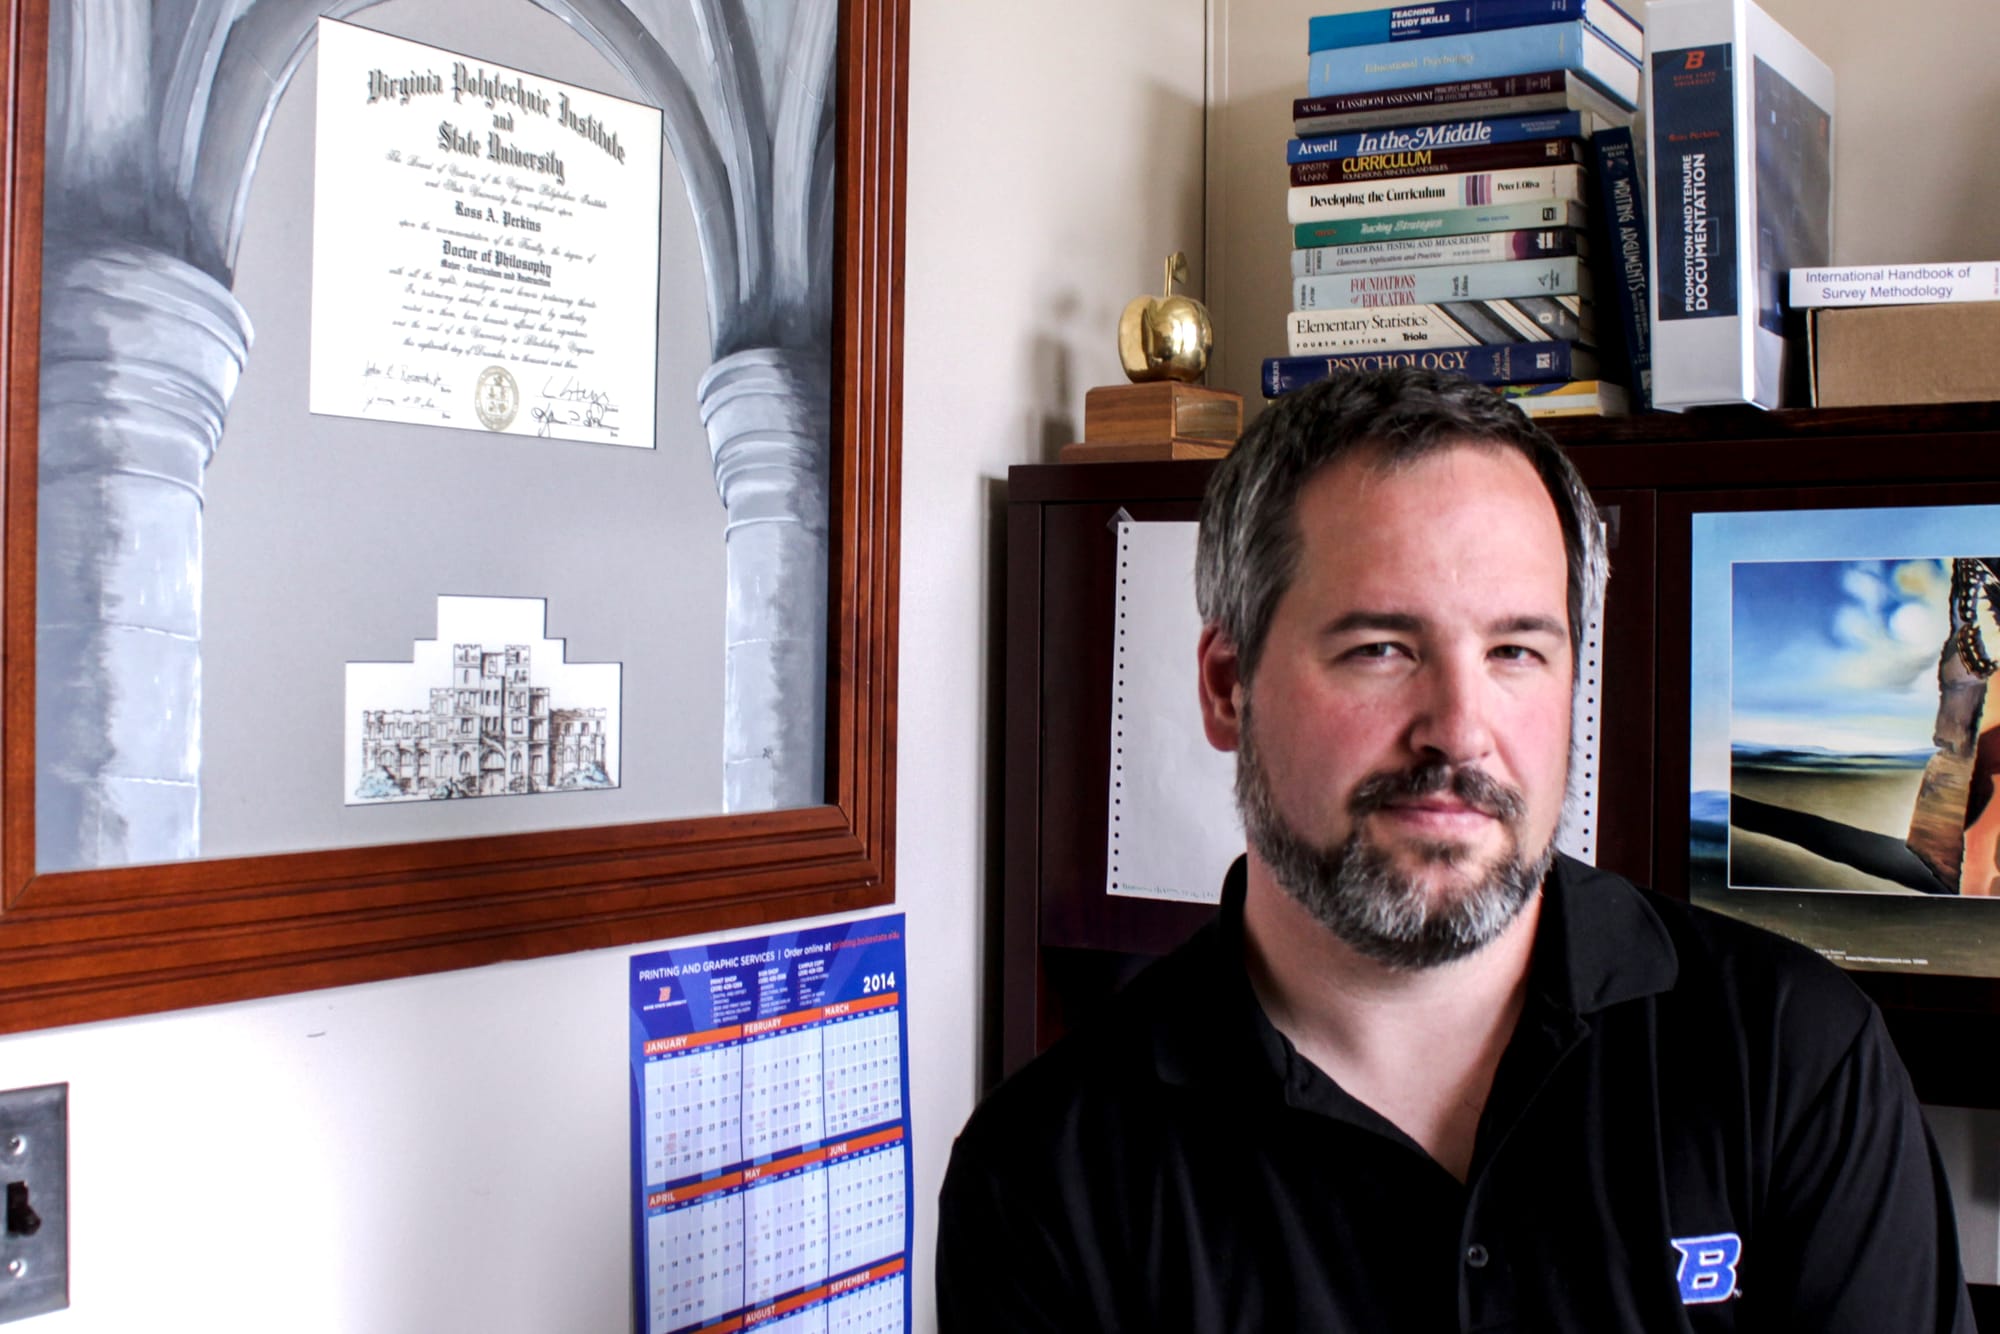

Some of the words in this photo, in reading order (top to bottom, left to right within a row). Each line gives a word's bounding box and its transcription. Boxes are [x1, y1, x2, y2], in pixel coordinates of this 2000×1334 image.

[1391, 7, 1435, 19] TEACHING
[1391, 17, 1419, 29] STUDY
[1420, 14, 1450, 26] SKILLS
[1364, 59, 1418, 73] Educational
[1423, 53, 1475, 68] Psychology
[1684, 49, 1706, 70] B
[366, 68, 444, 106] Virginia
[451, 61, 551, 118] Polytechnic
[558, 91, 625, 165] Institute
[493, 111, 514, 133] and
[1357, 133, 1377, 152] In
[1379, 130, 1409, 150] the
[1408, 121, 1492, 150] Middle
[437, 120, 481, 158] State
[487, 130, 566, 186] University
[1298, 140, 1337, 155] Atwell
[1342, 150, 1432, 173] CURRICULUM
[1497, 182, 1515, 192] Peter
[1522, 181, 1540, 190] Oliva
[1682, 153, 1693, 201] TENURE
[1310, 192, 1365, 208] Developing
[1368, 190, 1385, 204] the
[1386, 186, 1446, 201] Curriculum
[1614, 178, 1635, 223] WRITING
[455, 200, 482, 220] Ross
[485, 207, 499, 223] A.
[503, 210, 541, 232] Perkins
[1684, 206, 1694, 234] AND
[1360, 222, 1393, 236] Teaching
[1394, 218, 1443, 232] Strategies
[1693, 153, 1709, 311] DOCUMENTATION
[1336, 246, 1383, 256] EDUCATIONAL
[1386, 242, 1415, 252] TESTING
[1417, 240, 1433, 250] AND
[1436, 235, 1491, 247] MEASUREMENT
[443, 239, 478, 260] Doctor
[481, 249, 493, 263] of
[495, 250, 552, 279] Philosophy
[1620, 227, 1646, 292] ARGUMENTS
[1350, 274, 1416, 293] FOUNDATIONS
[1684, 236, 1695, 312] PROMOTION
[1805, 269, 1884, 283] International
[1888, 267, 1954, 281] Handbook
[1958, 266, 1972, 278] of
[1362, 290, 1416, 308] EDUCATION
[1822, 287, 1866, 301] Survey
[1870, 285, 1953, 299] Methodology
[1297, 319, 1370, 335] Elementary
[1371, 312, 1428, 329] Statistics
[1296, 340, 1337, 349] FOURTH
[1343, 337, 1387, 346] EDITION
[1402, 331, 1428, 342] Triola
[639, 966, 680, 982] PRINTING
[681, 962, 701, 975] AND
[703, 957, 739, 972] GRAPHIC
[740, 951, 775, 966] SERVICES
[784, 948, 803, 959] Order
[804, 944, 824, 956] online
[824, 942, 832, 952] at
[863, 971, 896, 993] 2014
[825, 1002, 849, 1017] MARCH
[744, 1017, 782, 1034] FEBRUARY
[646, 1036, 688, 1054] JANUARY
[830, 1142, 847, 1157] JUNE
[745, 1168, 761, 1180] MAY
[649, 1192, 676, 1206] APRIL
[1670, 1232, 1742, 1304] B
[831, 1271, 870, 1293] SEPTEMBER
[745, 1305, 776, 1323] AUGUST
